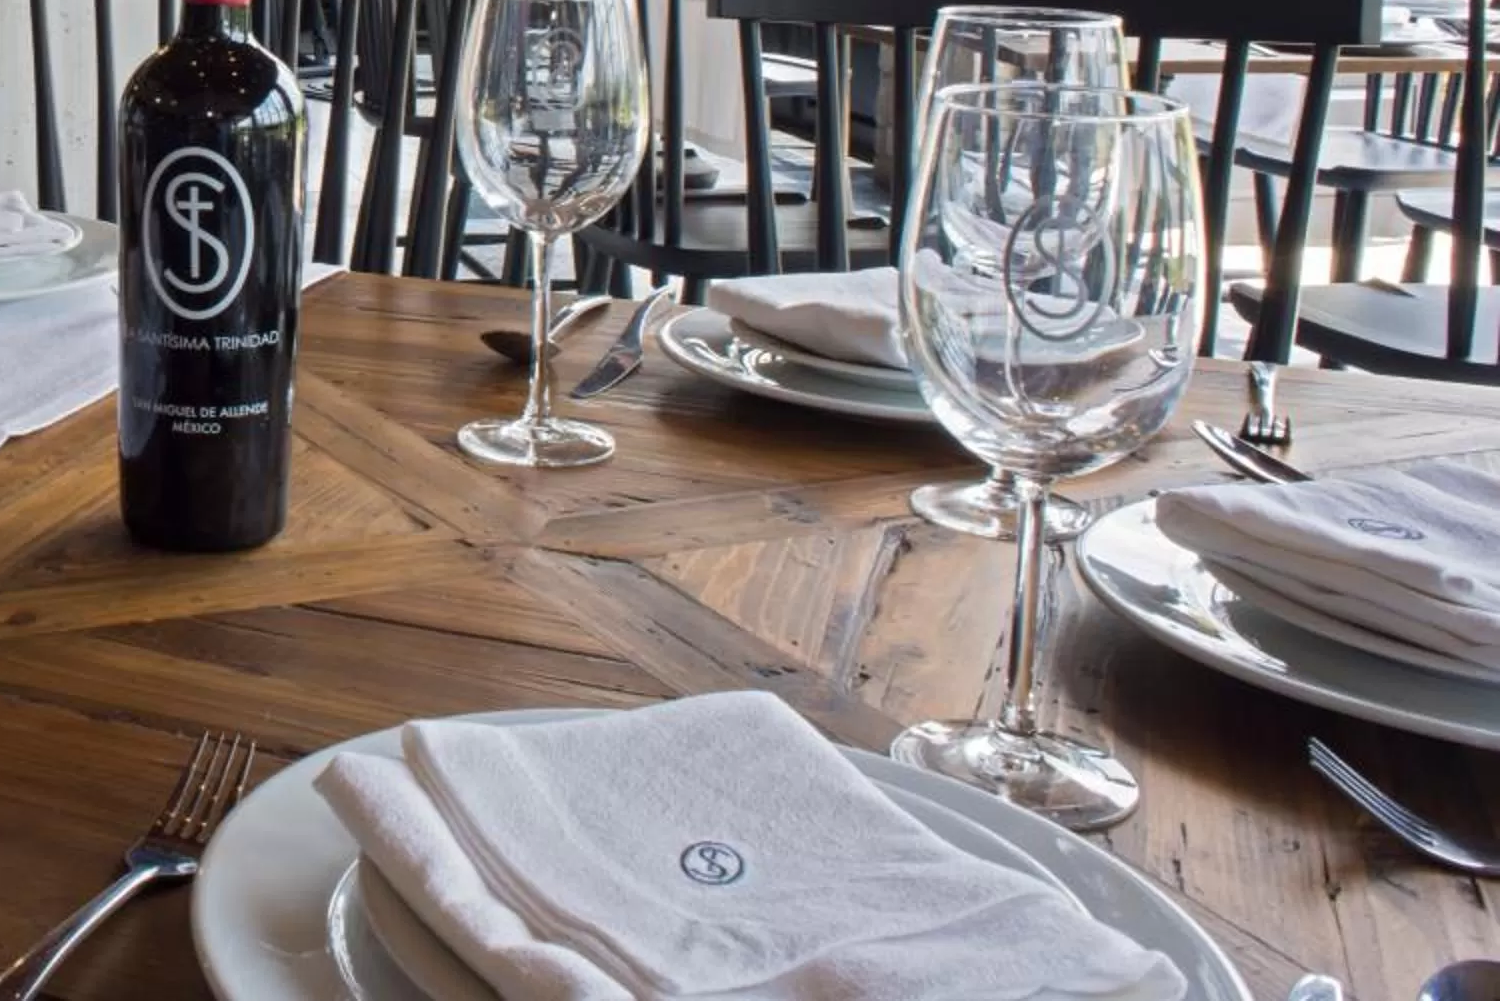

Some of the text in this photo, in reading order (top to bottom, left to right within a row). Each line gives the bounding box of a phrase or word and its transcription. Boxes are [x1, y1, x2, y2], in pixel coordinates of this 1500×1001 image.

[214, 330, 280, 350] TRINIDAD
[153, 402, 197, 418] MIGUEL
[200, 406, 217, 418] DE
[219, 400, 269, 418] ALLENDE
[173, 421, 222, 434] MÉXICO
